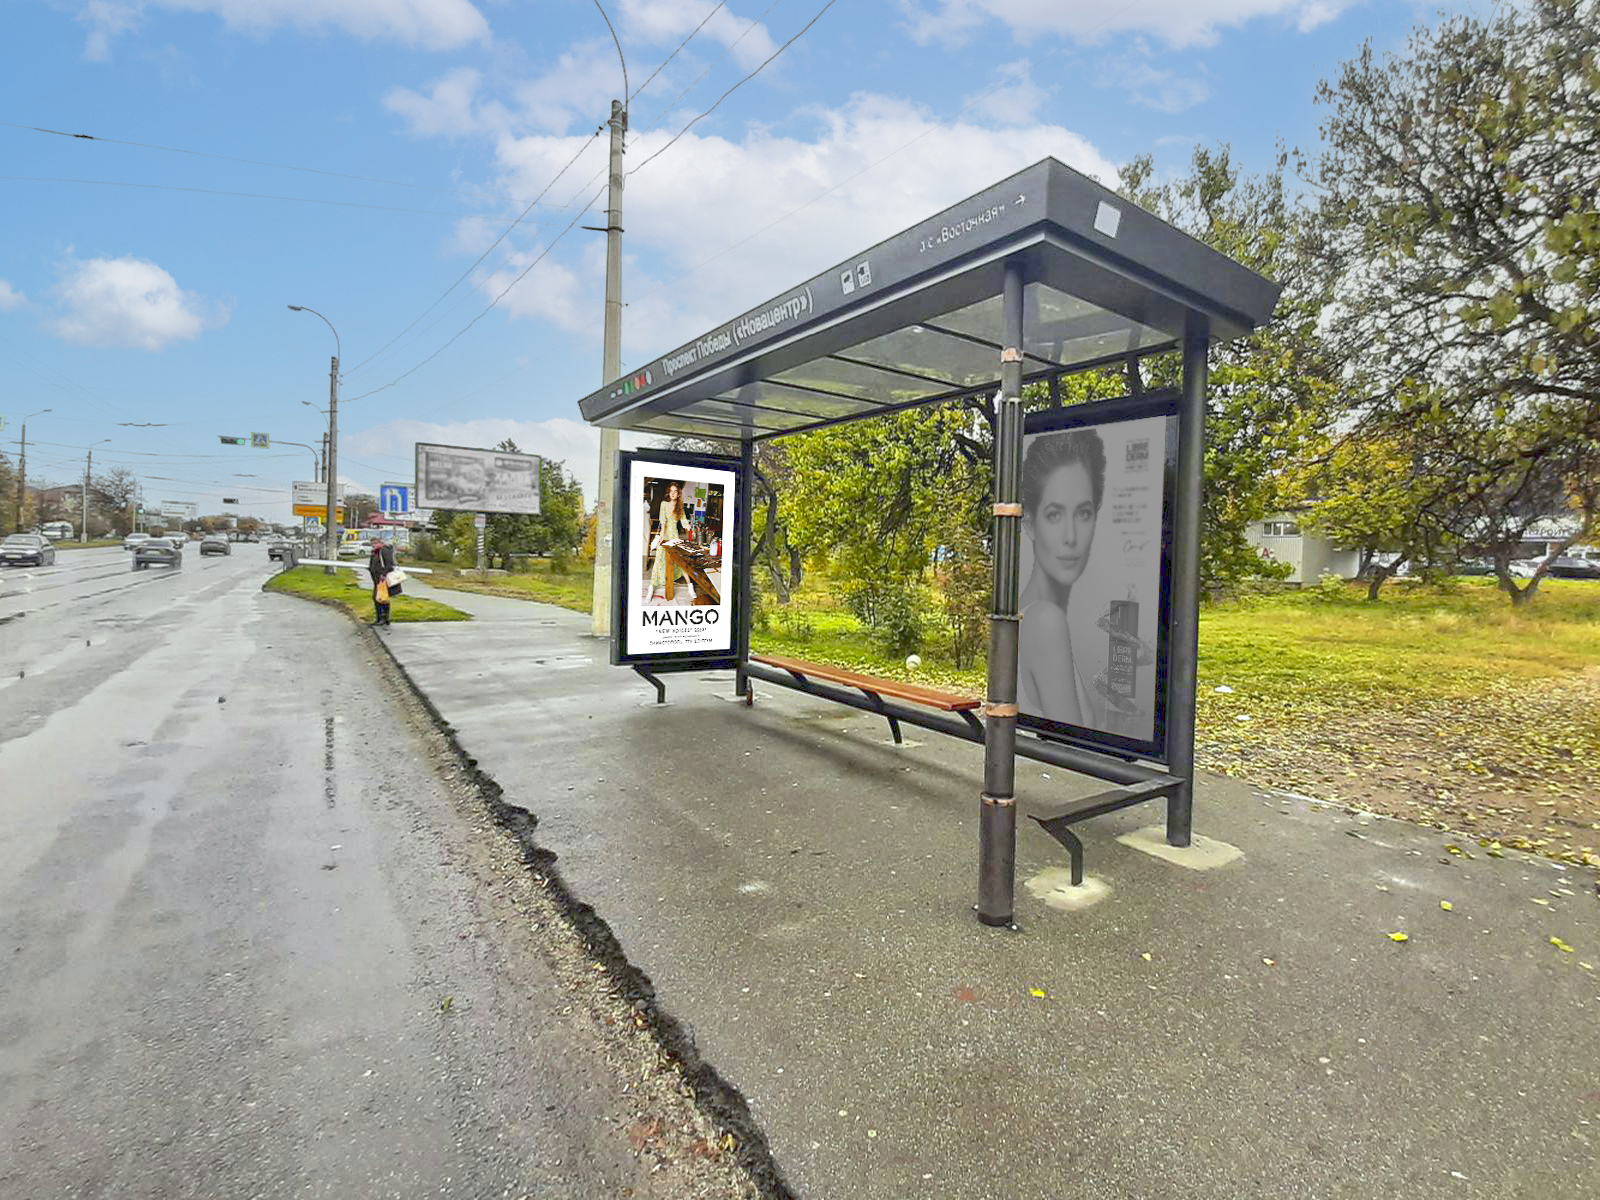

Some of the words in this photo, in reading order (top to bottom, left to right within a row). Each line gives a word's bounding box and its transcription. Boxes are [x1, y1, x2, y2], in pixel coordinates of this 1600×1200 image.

[662, 347, 697, 376] Проспект
[696, 332, 732, 360] Победы
[731, 287, 813, 346] («Новацентр»)
[1126, 442, 1149, 453] LIBRE
[1126, 452, 1149, 462] DERM
[642, 609, 719, 627] MANGO
